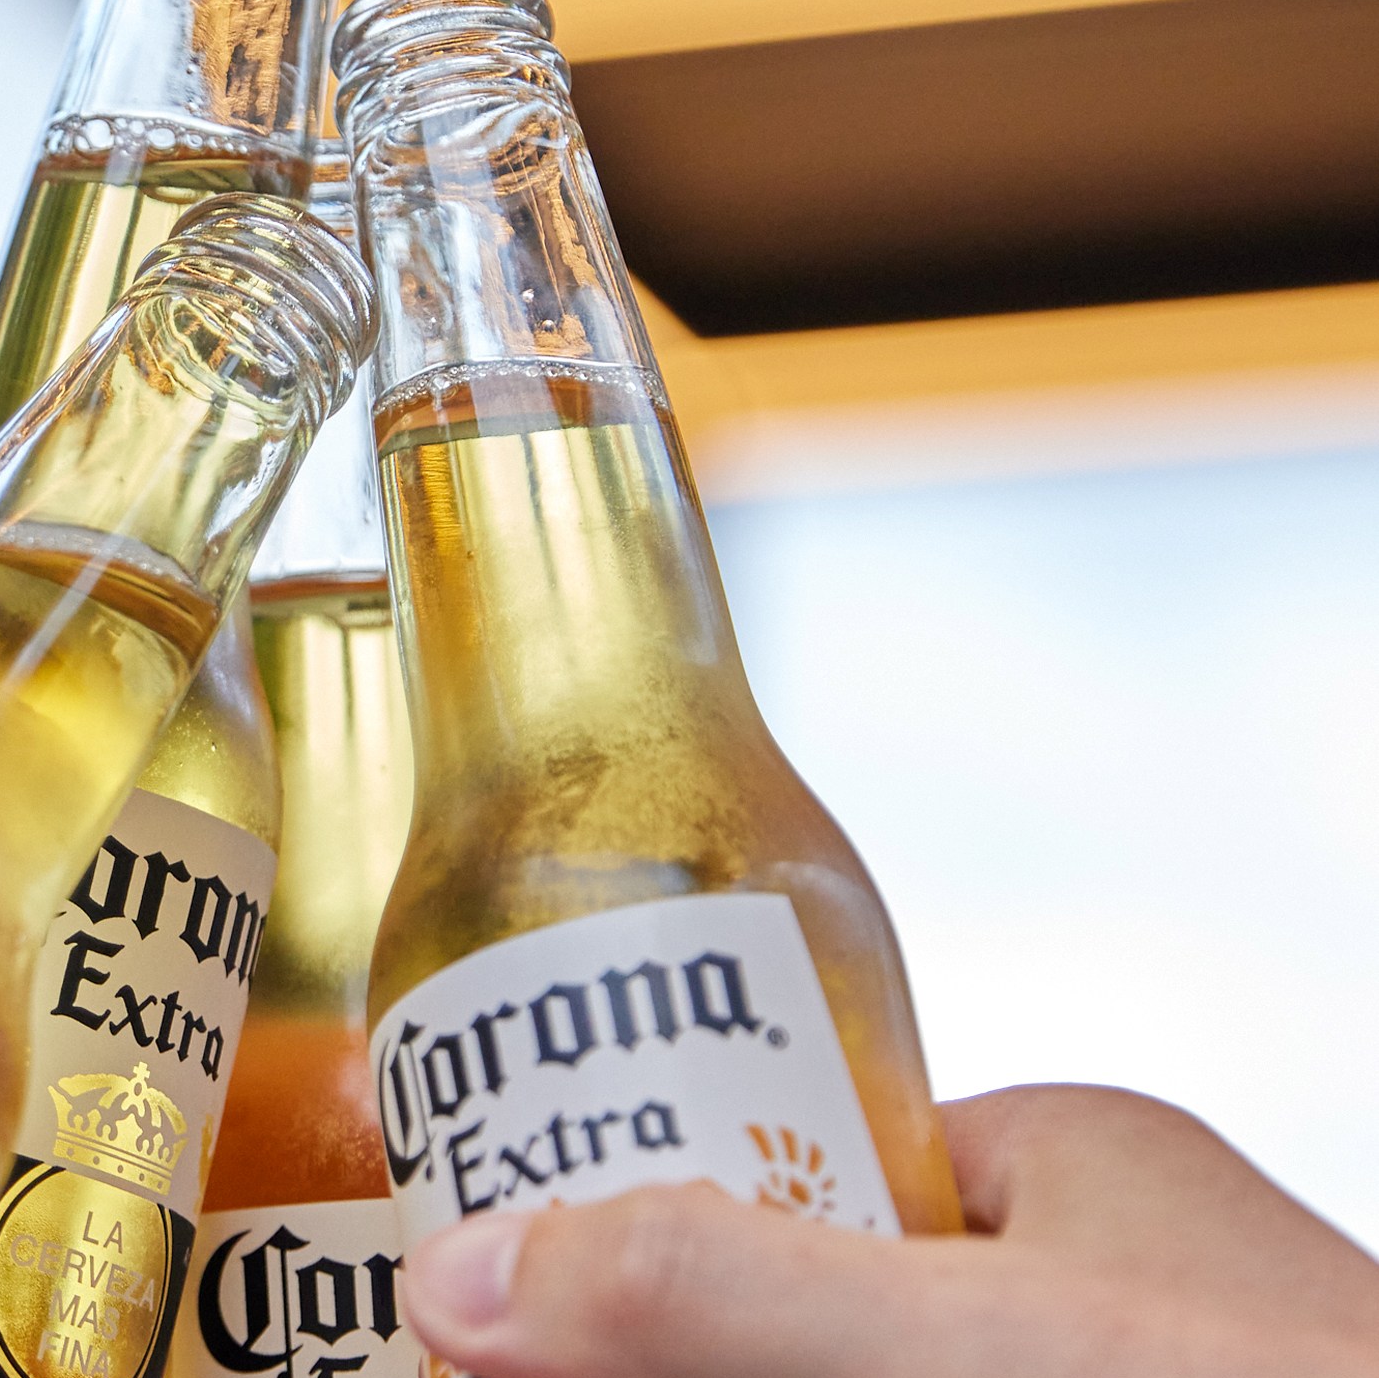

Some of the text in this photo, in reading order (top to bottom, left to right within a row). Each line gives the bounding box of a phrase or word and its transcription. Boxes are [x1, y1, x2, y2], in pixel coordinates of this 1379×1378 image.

[55, 835, 268, 994] oron
[50, 930, 224, 1082] Extra
[379, 950, 762, 1188] Corona
[445, 1097, 685, 1220] Extra
[9, 1233, 156, 1312] CERVEZA
[82, 1210, 123, 1255] LA
[48, 1288, 121, 1341] MAS
